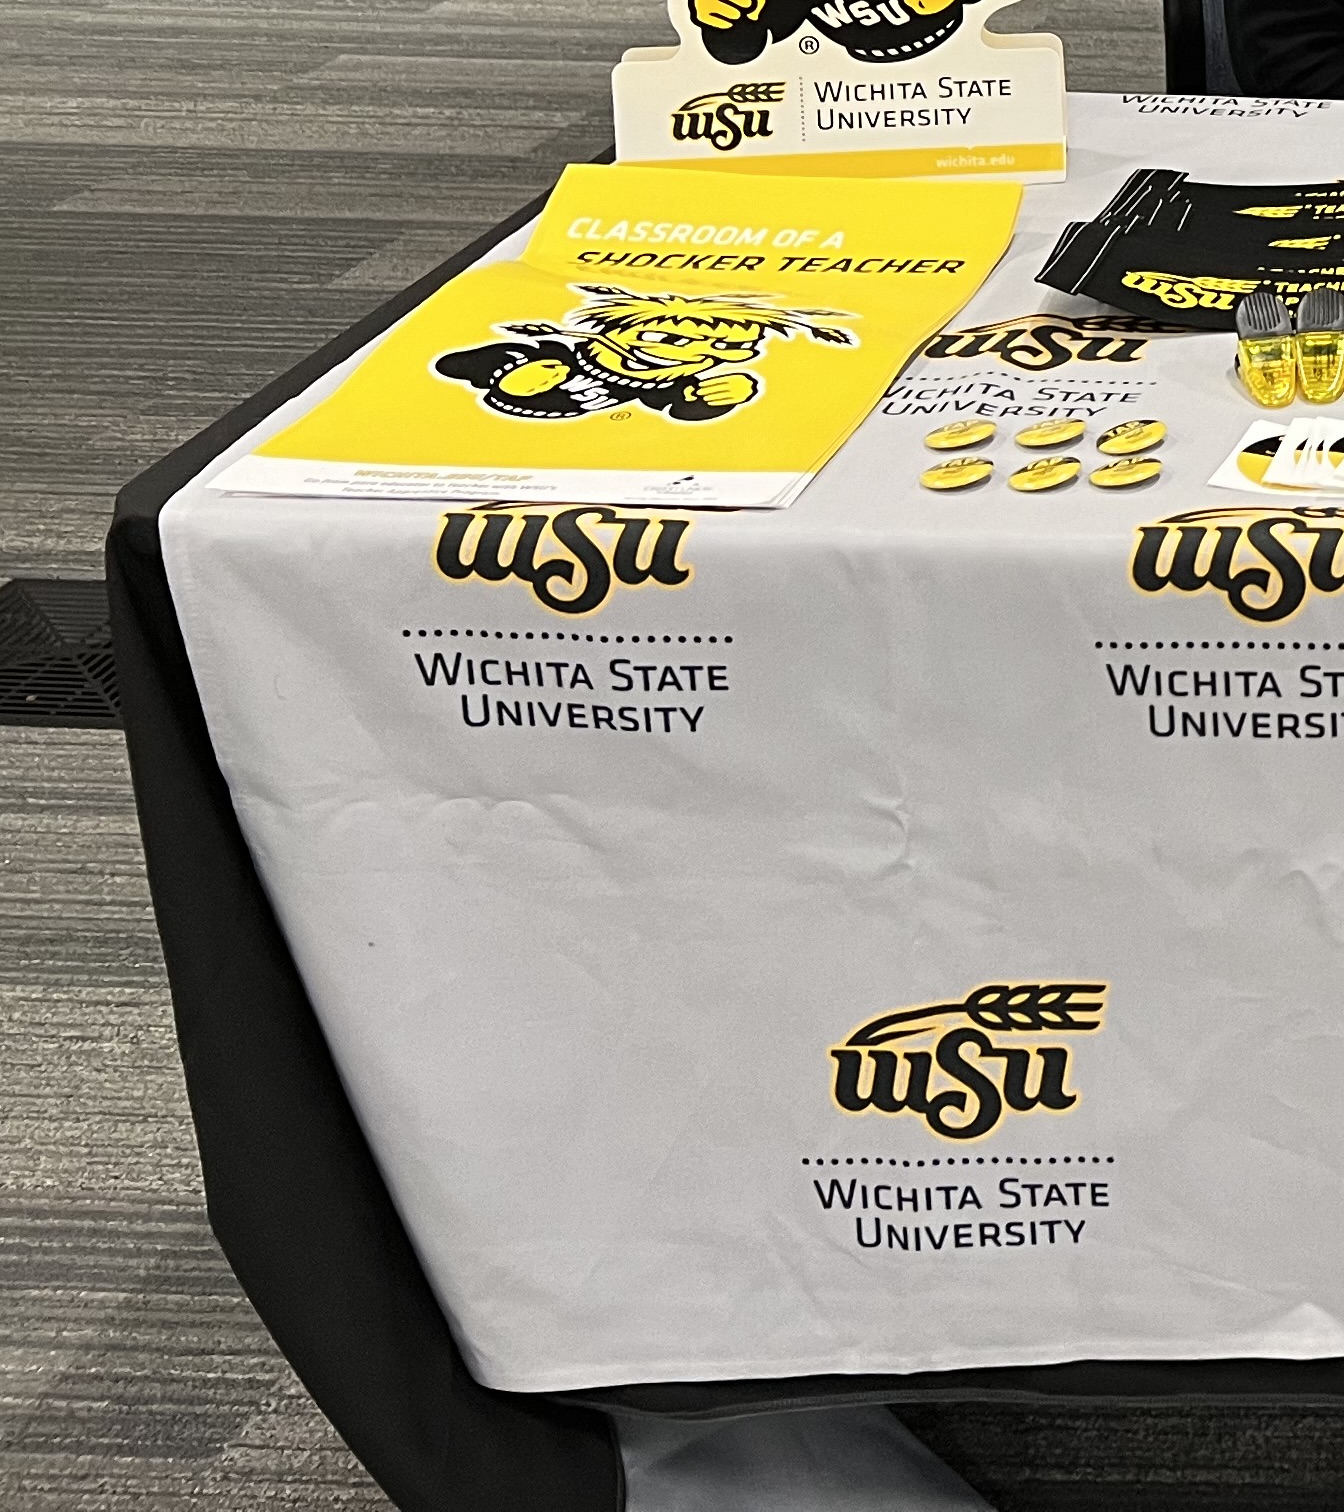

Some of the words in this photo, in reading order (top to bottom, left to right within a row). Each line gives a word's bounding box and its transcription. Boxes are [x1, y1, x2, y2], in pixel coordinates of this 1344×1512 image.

[813, 80, 928, 102] WICHITA
[938, 76, 1013, 99] STATE
[816, 106, 972, 131] UNIVERSITY
[1138, 104, 1308, 118] UNIVERSITY
[935, 153, 1016, 169] wichita.edu
[566, 217, 764, 248] CLASSROOM
[771, 229, 814, 248] OF
[818, 231, 847, 249] A
[576, 251, 765, 272] SHOCKER
[772, 256, 967, 274] TEACHER
[1036, 387, 1143, 404] STATE
[882, 400, 1106, 418] UNIVERSITY
[415, 652, 594, 690] WICHITA
[608, 658, 730, 692] STATE
[1106, 663, 1282, 699] WICHITA
[461, 695, 705, 734] UNIVERSITY
[813, 1178, 983, 1212] WICHITA
[999, 1177, 1110, 1208] STATE
[855, 1216, 1086, 1251] UNIVERSITY
